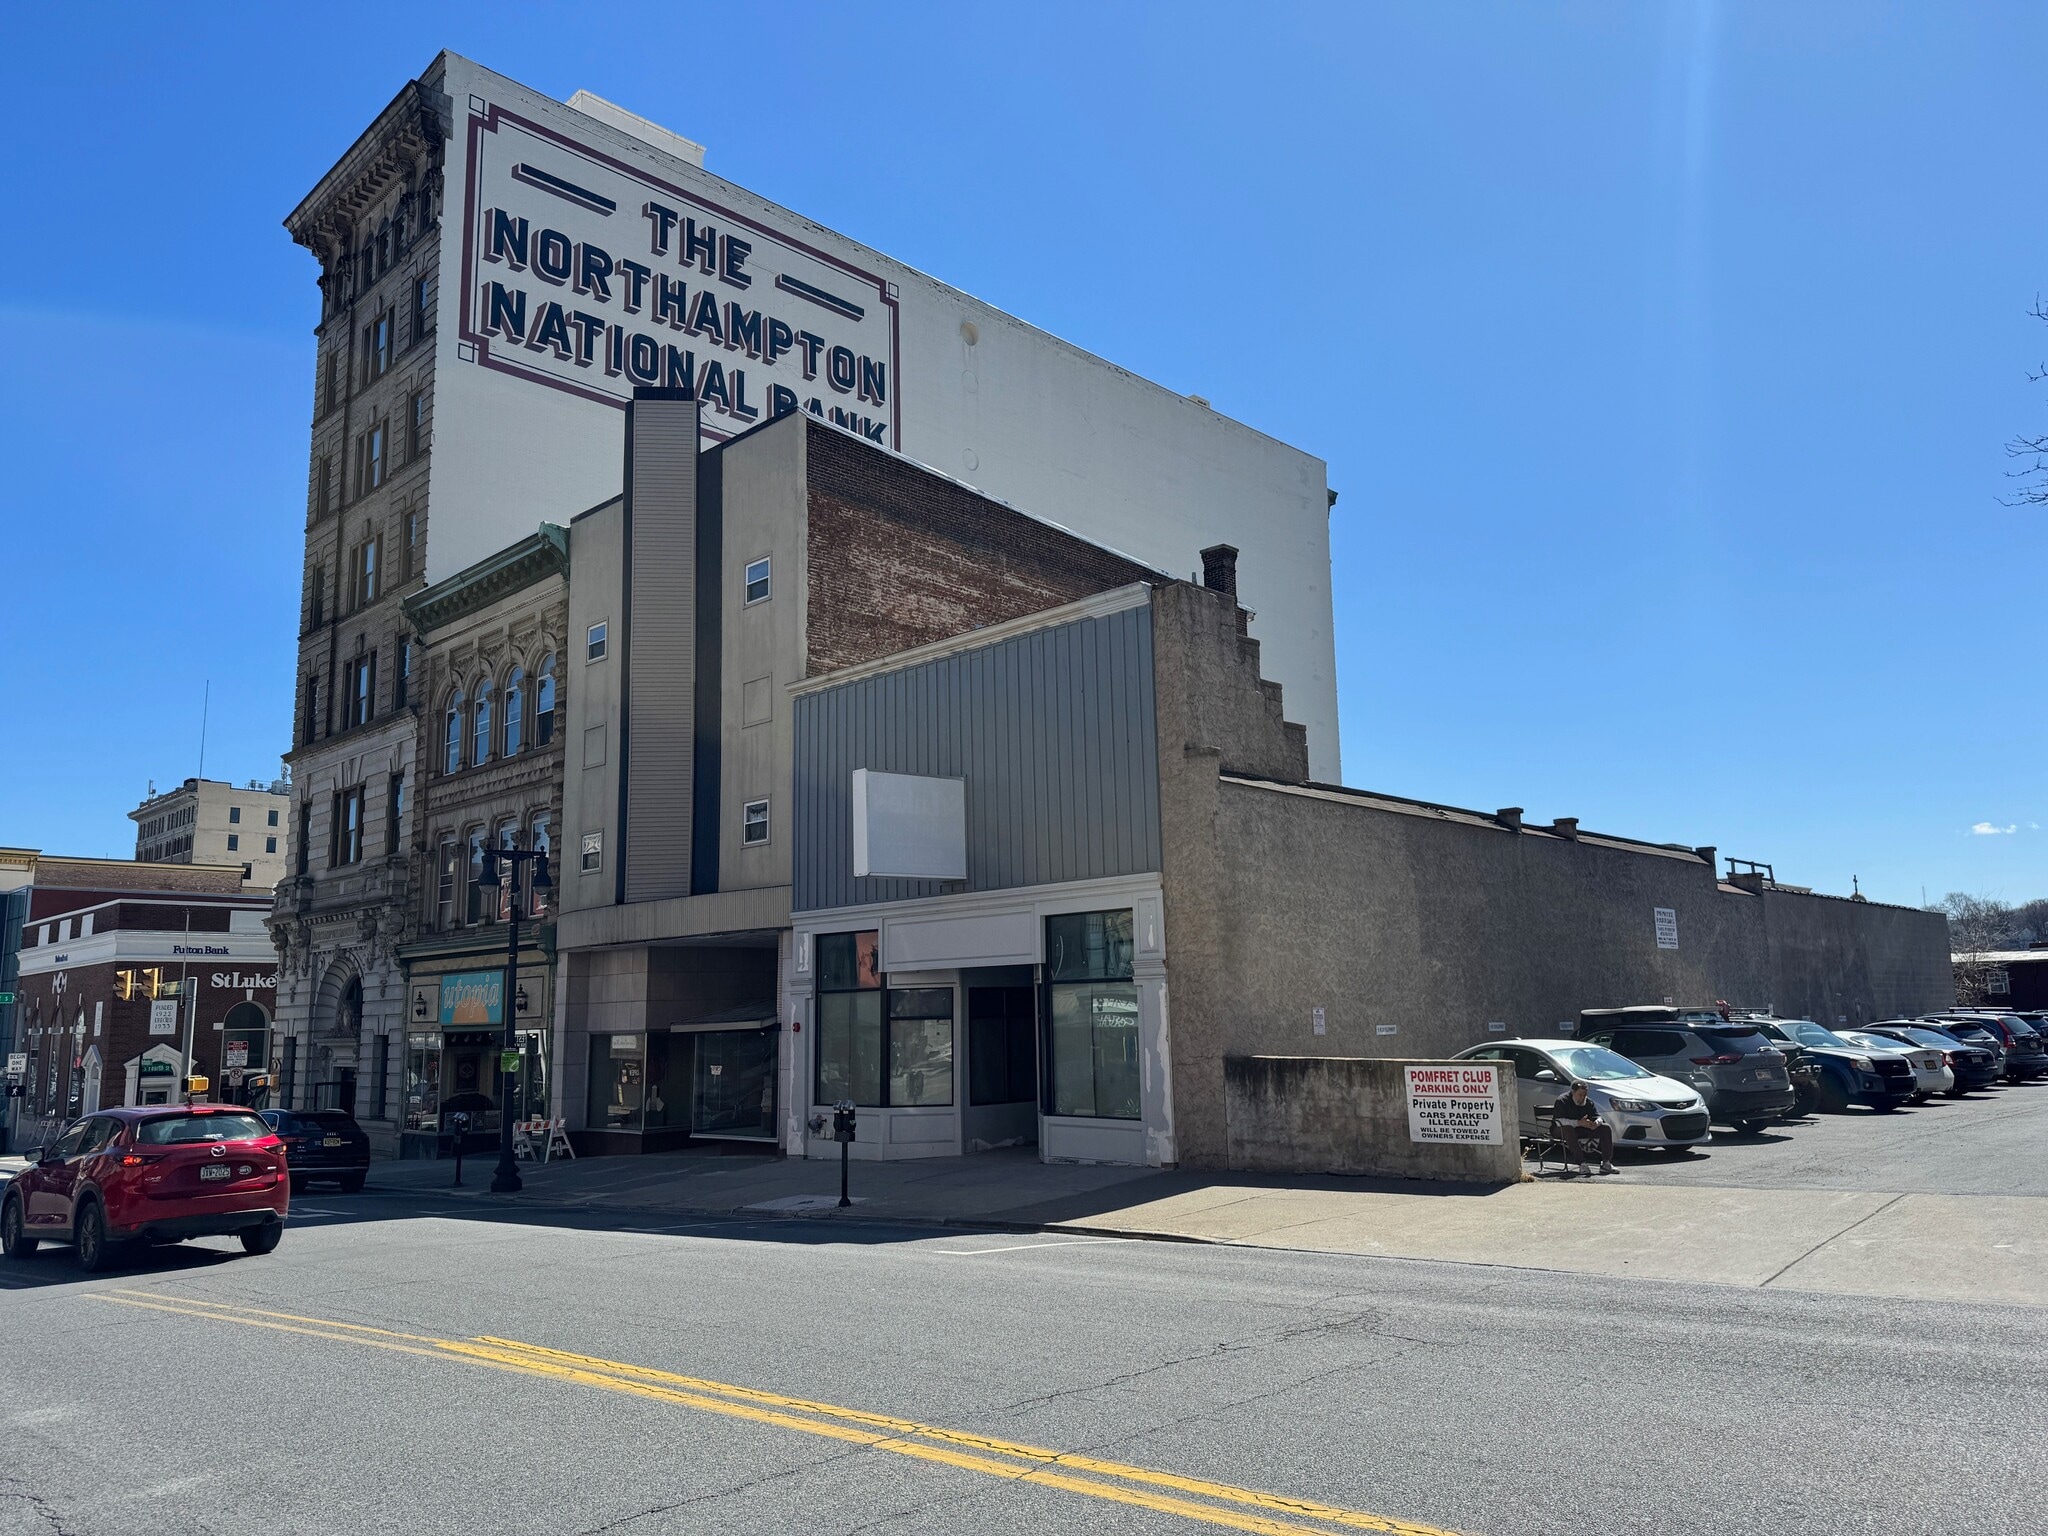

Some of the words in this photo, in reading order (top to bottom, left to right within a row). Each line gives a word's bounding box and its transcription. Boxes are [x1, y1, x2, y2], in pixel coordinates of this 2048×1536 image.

[642, 201, 752, 290] THE
[482, 207, 886, 408] NORTHAMPTON
[481, 280, 759, 424] NATIONAL
[205, 945, 230, 955] Bank
[444, 974, 500, 1018] utopia
[1410, 1070, 1460, 1083] POMFRET
[1462, 1070, 1492, 1083] CLUB
[1414, 1084, 1460, 1093] PARKING
[1462, 1084, 1489, 1094] ONLY
[1412, 1098, 1447, 1110] Private
[1450, 1099, 1495, 1113] Property
[1419, 1111, 1446, 1119] CARS
[1448, 1112, 1490, 1120] PARKED
[1428, 1118, 1480, 1127] ILLEGALLY
[1455, 1133, 1490, 1141] EXPENSE
